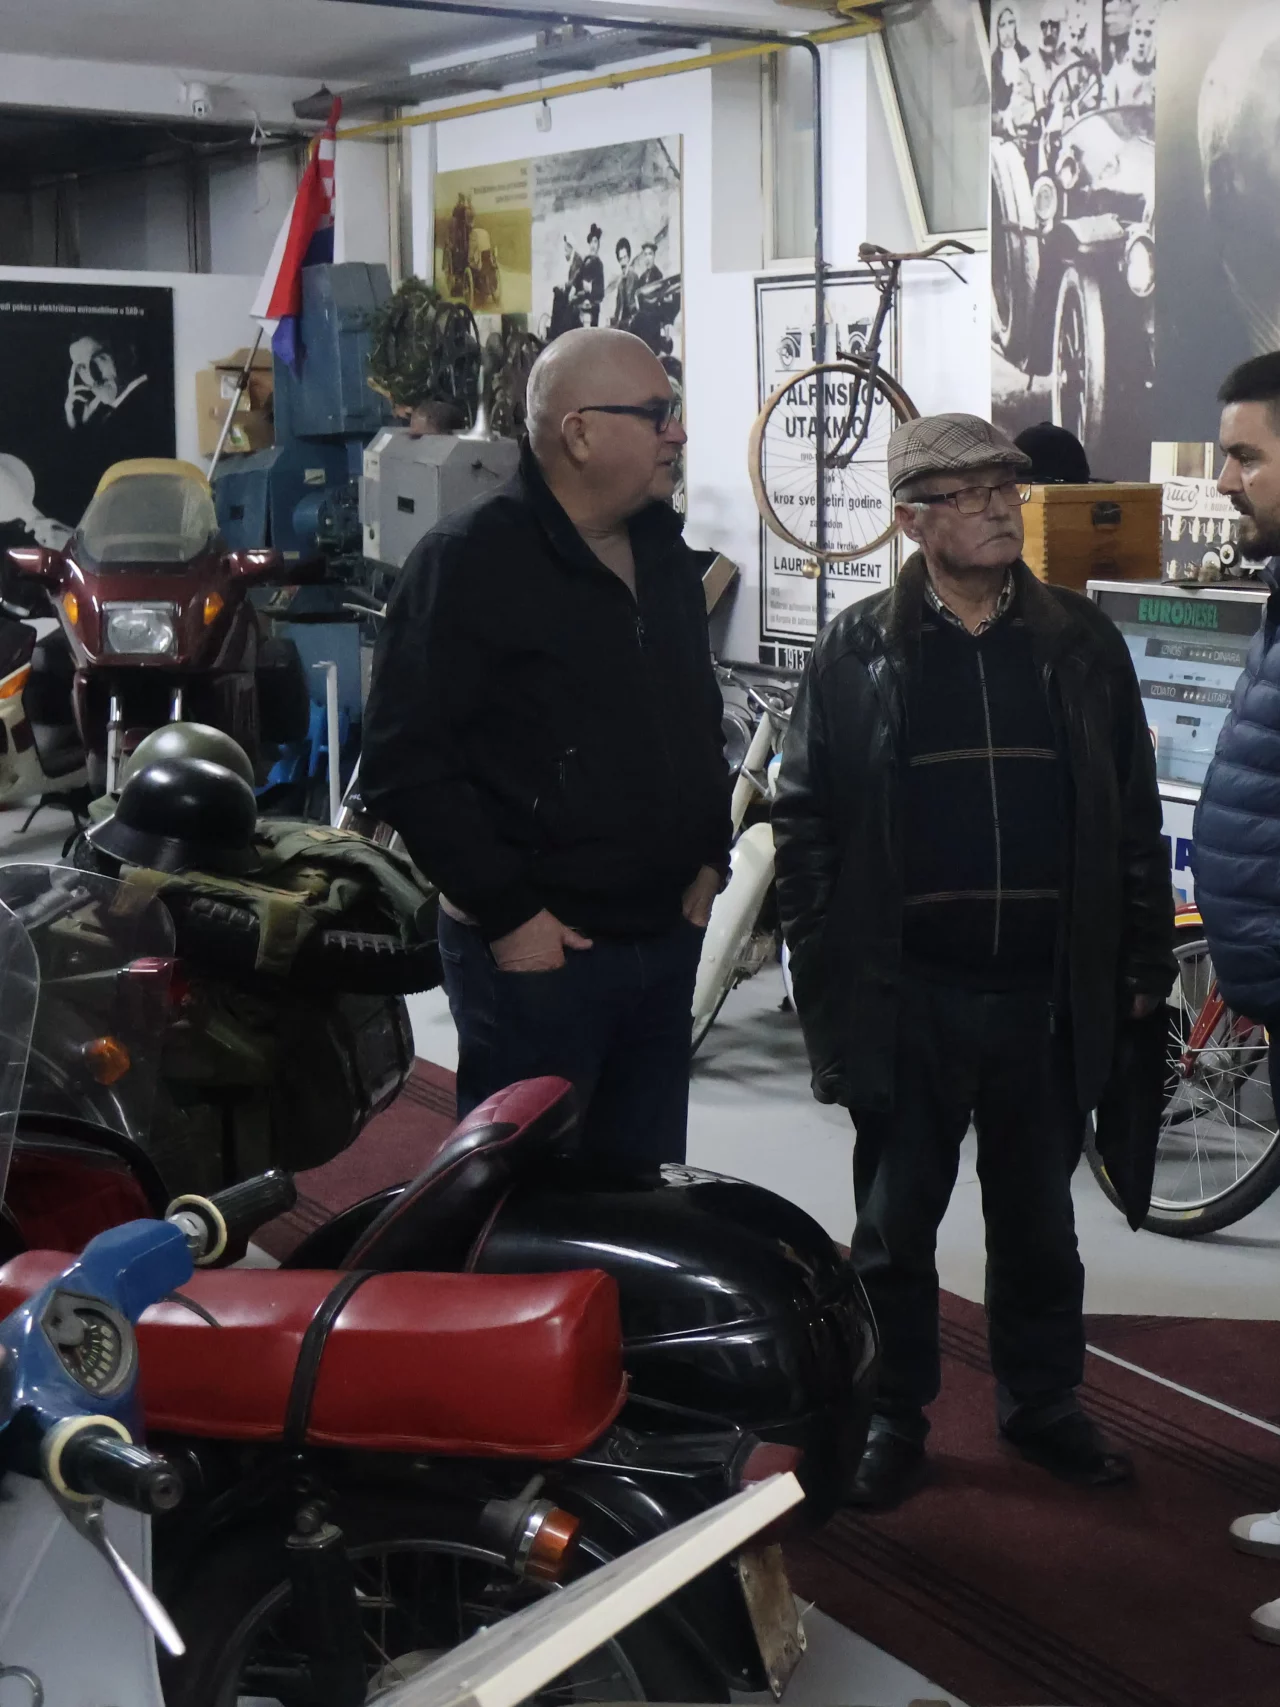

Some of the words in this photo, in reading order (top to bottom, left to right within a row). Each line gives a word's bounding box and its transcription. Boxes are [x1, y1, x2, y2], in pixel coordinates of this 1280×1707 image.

[774, 491, 795, 505] kroz
[799, 494, 816, 506] sve
[849, 495, 883, 511] godine
[829, 562, 882, 579] KLEMENT
[1138, 597, 1219, 629] EURODIESEL
[1213, 650, 1241, 664] DINARA
[1150, 684, 1177, 697] IZDATO
